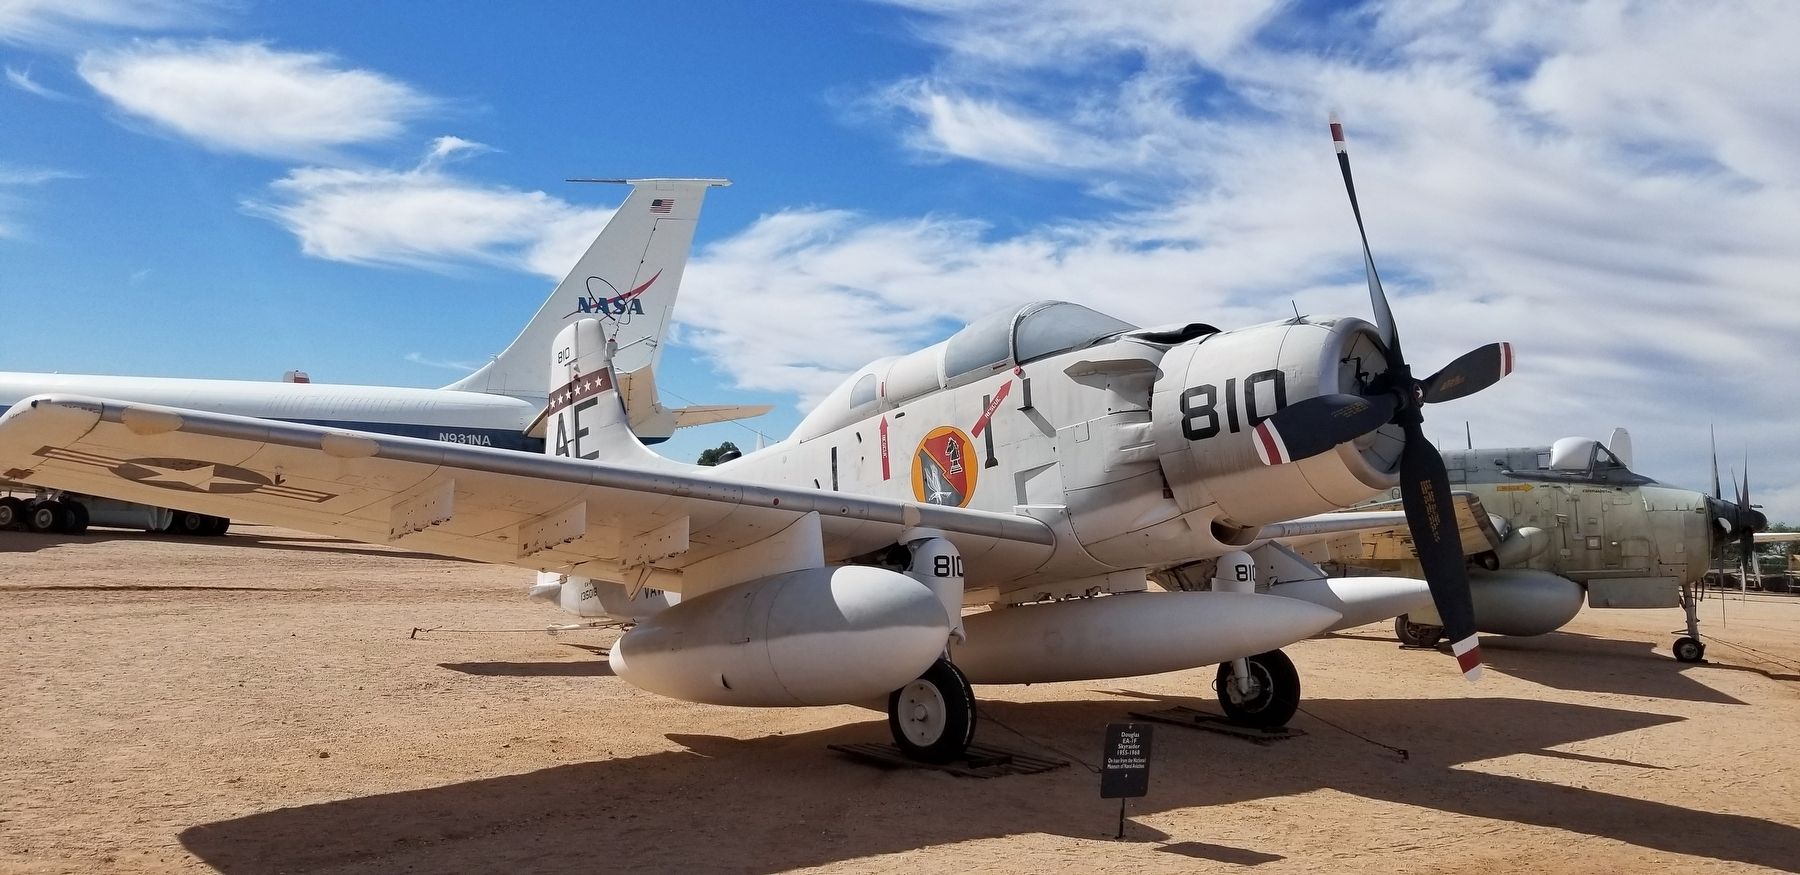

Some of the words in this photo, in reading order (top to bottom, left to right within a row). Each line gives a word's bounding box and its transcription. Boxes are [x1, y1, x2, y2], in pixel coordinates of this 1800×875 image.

[578, 297, 645, 315] NASA
[558, 347, 570, 364] 810
[985, 396, 1001, 419] RESCUE
[1180, 369, 1287, 441] 810
[556, 397, 599, 460] AE
[440, 432, 491, 446] N931NA
[1121, 731, 1140, 739] Douglas
